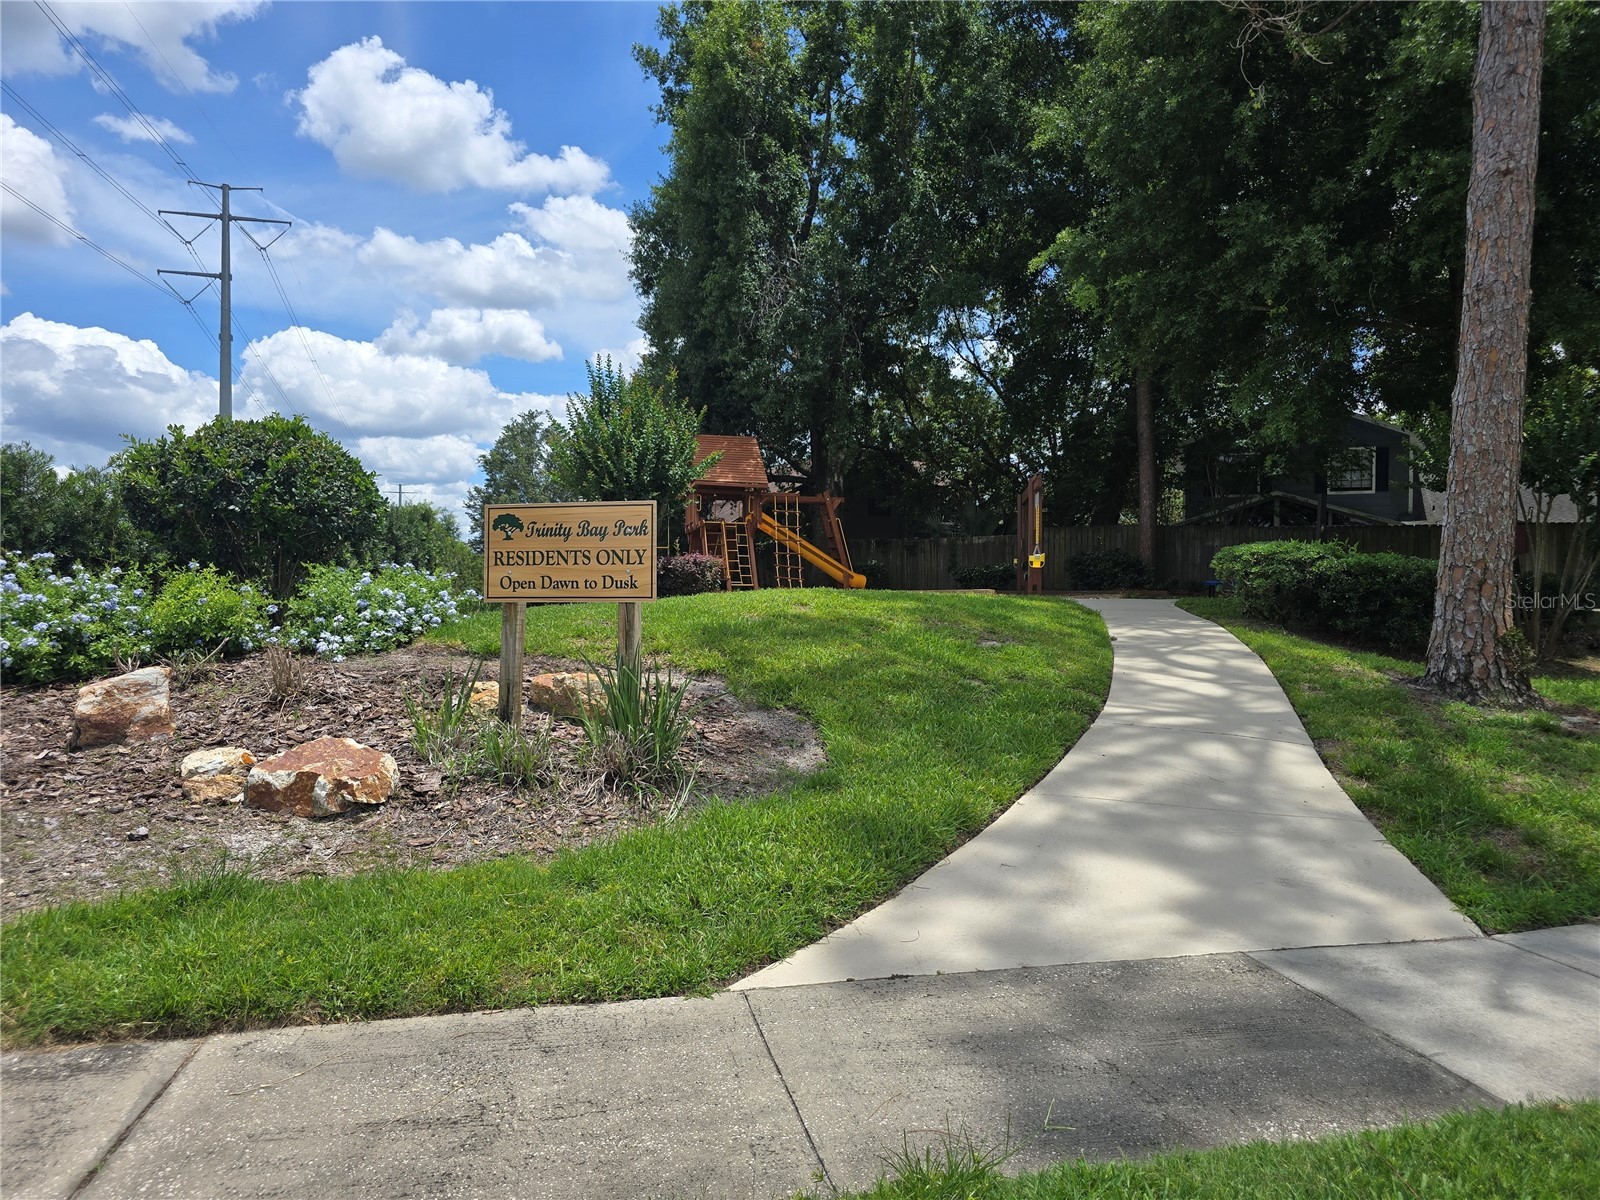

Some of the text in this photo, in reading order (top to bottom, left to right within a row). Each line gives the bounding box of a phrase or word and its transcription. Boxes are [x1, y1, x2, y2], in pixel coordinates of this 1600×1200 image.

[525, 519, 649, 542] Trinity Bay Park
[493, 549, 647, 566] RESIDENTS ONLY
[500, 575, 638, 592] Open Dawn to Dusk
